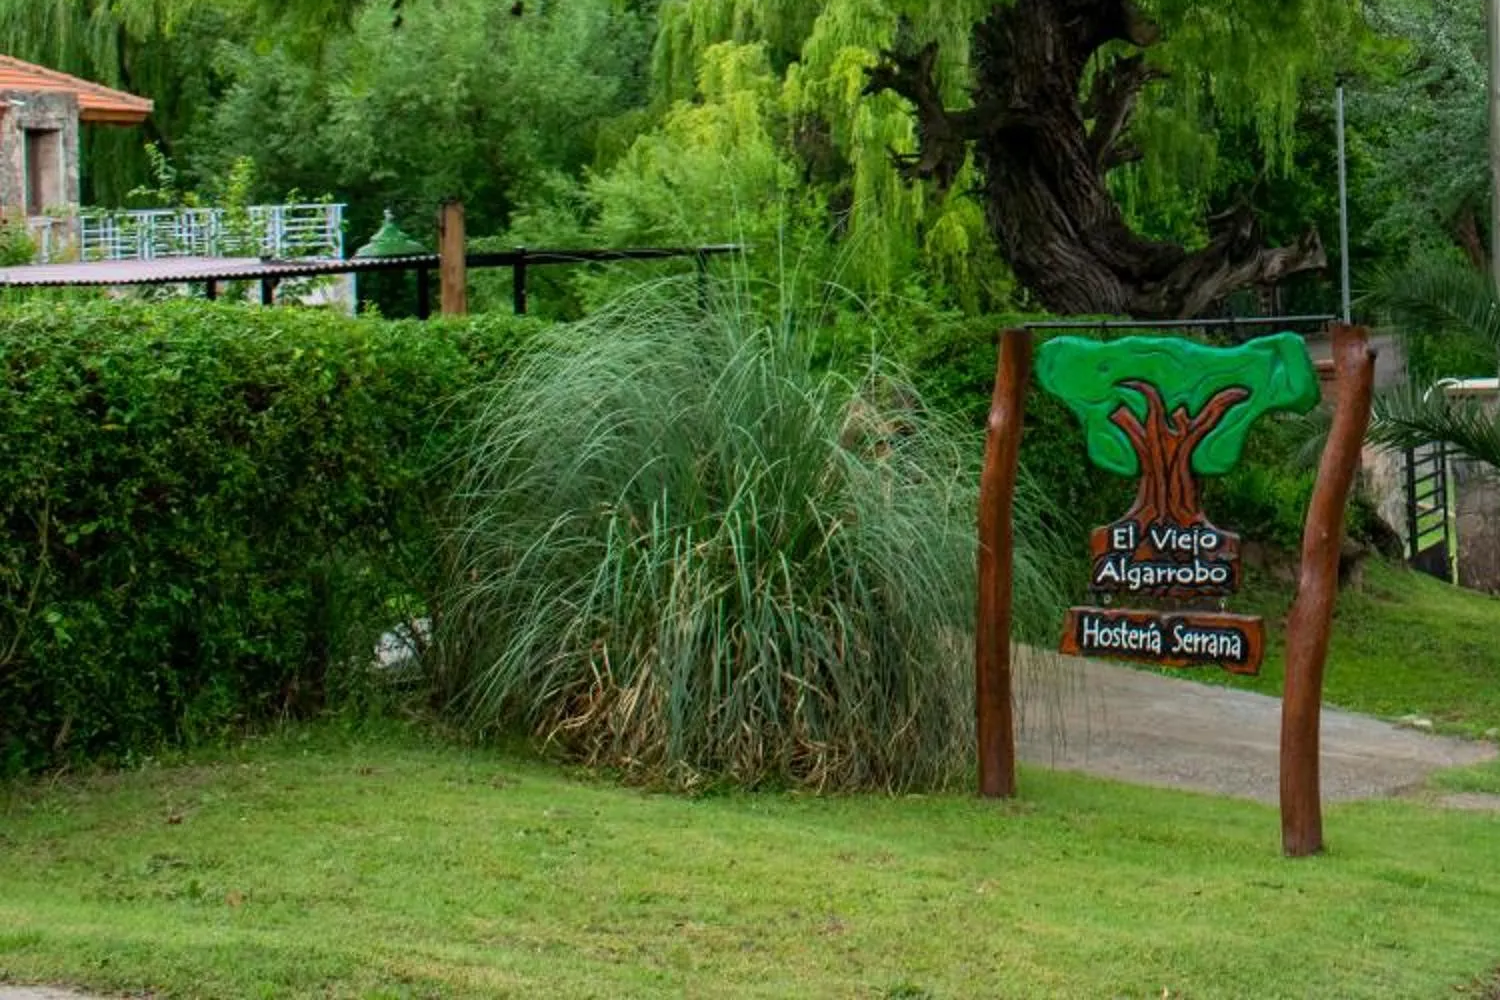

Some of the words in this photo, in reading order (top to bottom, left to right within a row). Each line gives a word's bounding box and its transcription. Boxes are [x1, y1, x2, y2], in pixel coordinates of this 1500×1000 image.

[1112, 525, 1134, 550] El
[1151, 528, 1218, 555] Viejo
[1096, 557, 1228, 590] Algarrobo
[1082, 616, 1161, 653] Hostería
[1171, 625, 1241, 660] Serrana
